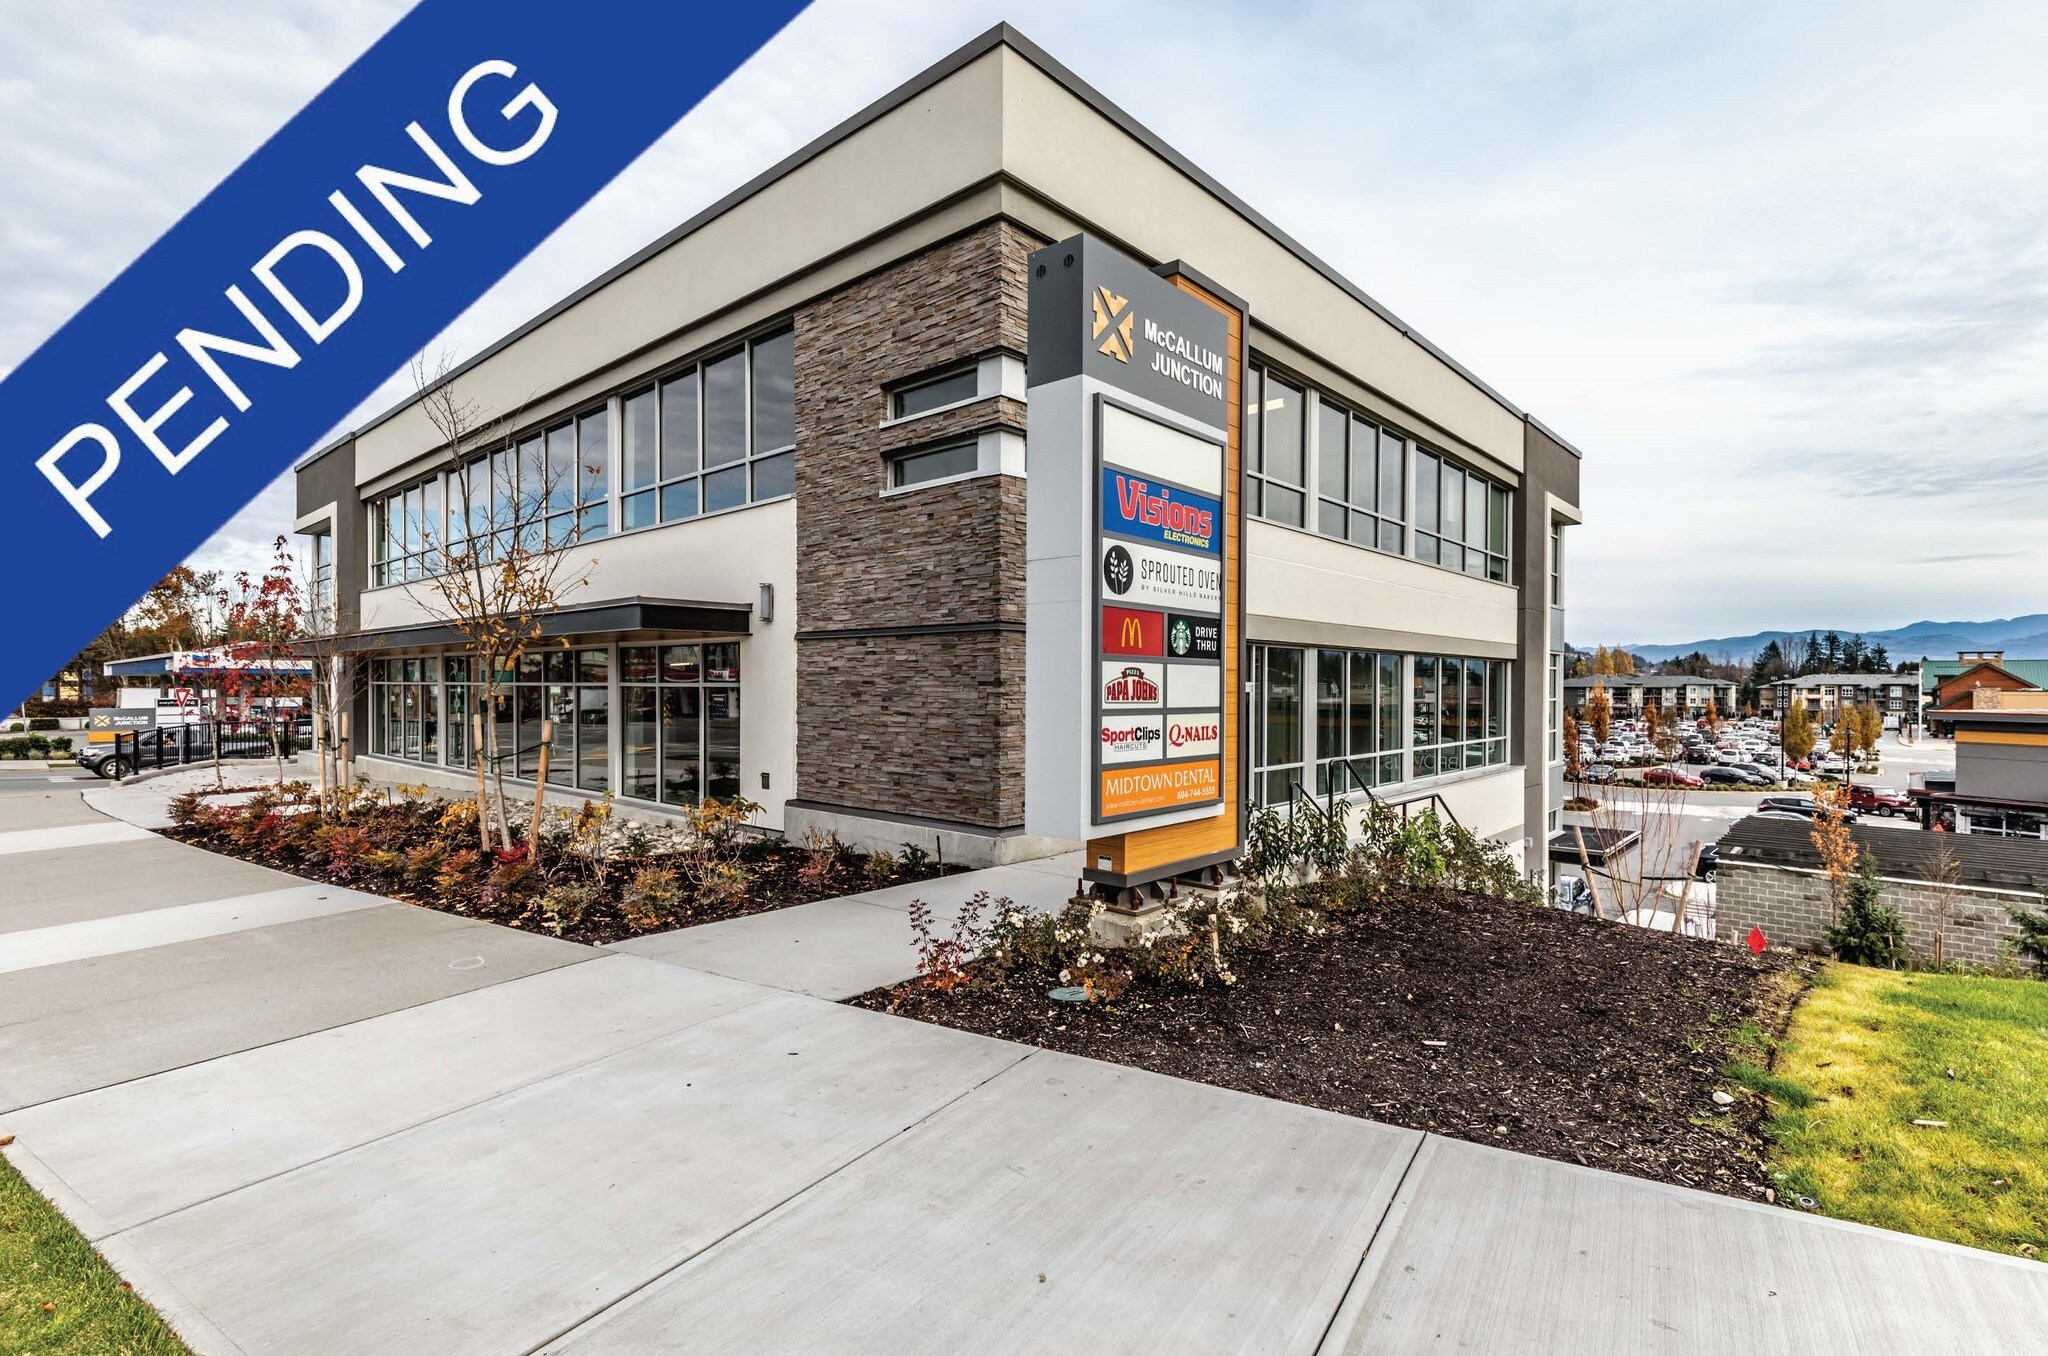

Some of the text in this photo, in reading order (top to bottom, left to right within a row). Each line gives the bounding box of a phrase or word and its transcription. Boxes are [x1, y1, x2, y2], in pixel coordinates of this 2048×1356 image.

[1144, 319, 1223, 376] McCALLUM
[1151, 351, 1222, 400] JUNCTION
[1116, 475, 1213, 538] Visions
[1163, 530, 1210, 548] ELECTRONICS
[1141, 558, 1221, 591] SPROUTED OVEN
[1195, 626, 1218, 639] DRIVE
[1196, 639, 1217, 651] THRU
[1106, 679, 1130, 701] PAPA
[1101, 726, 1161, 746] SportClips
[1114, 742, 1147, 750] HAIRCUTS
[1105, 767, 1216, 797] MIDTOWN DENTAL
